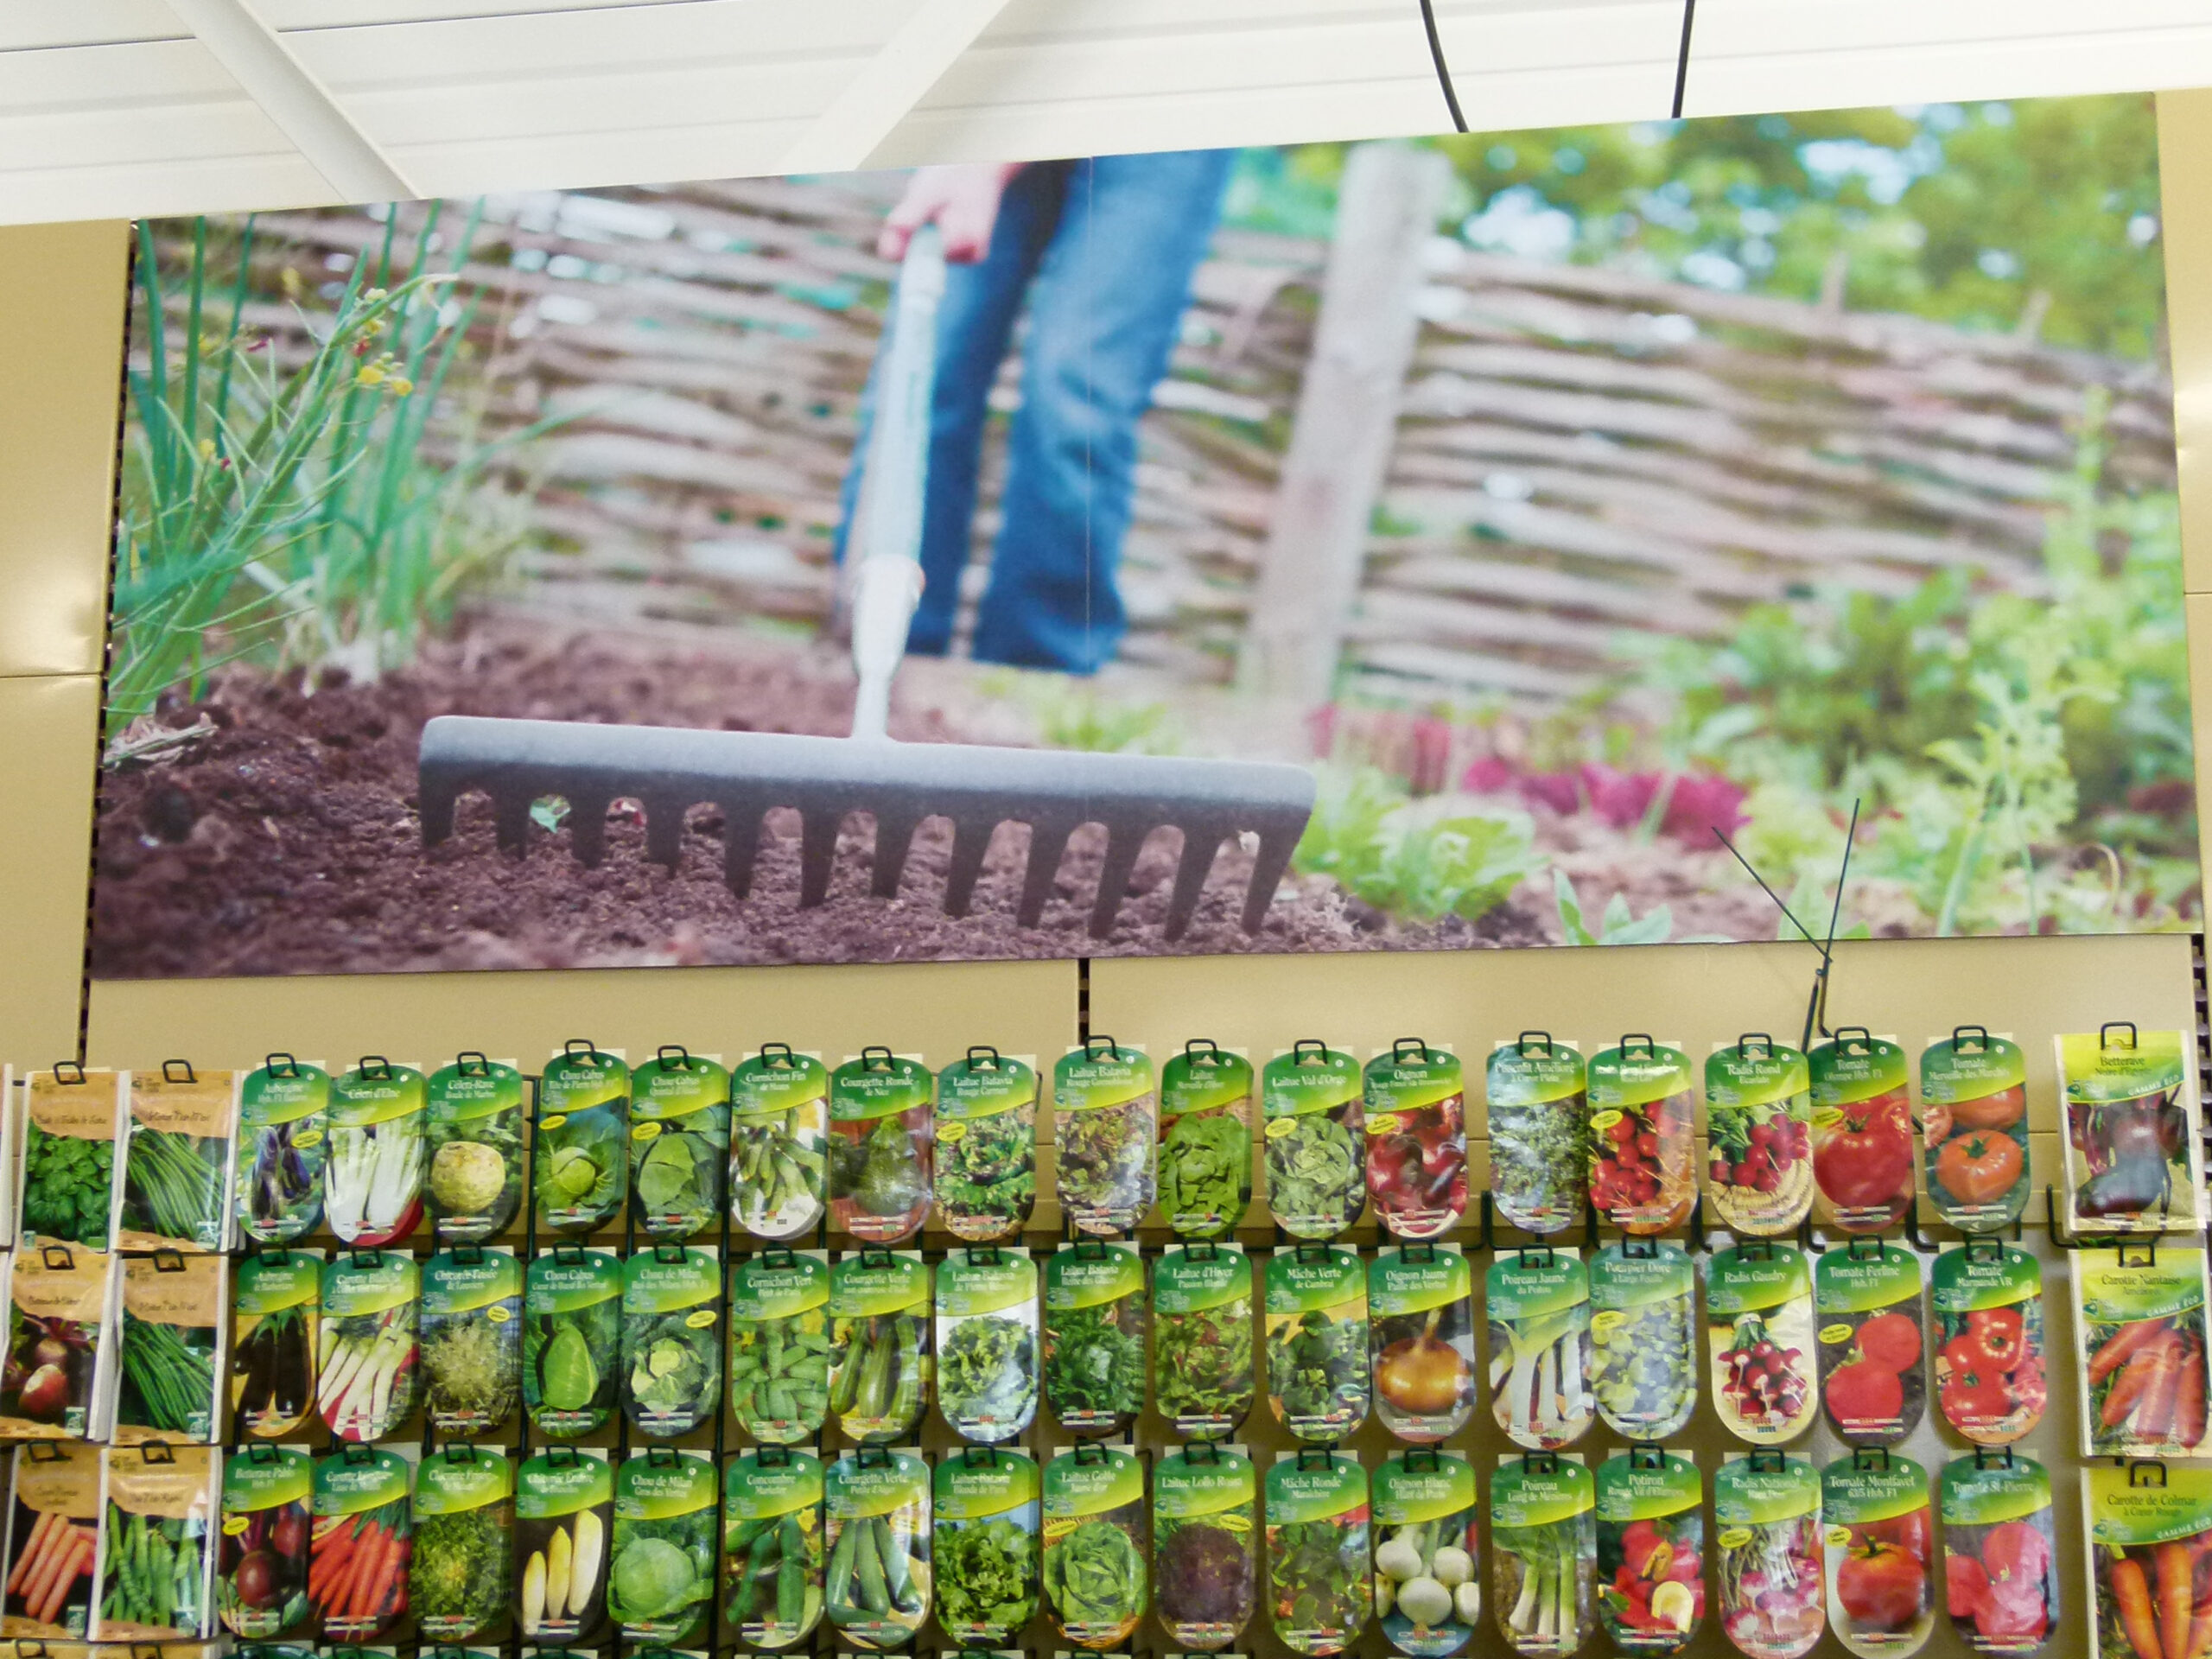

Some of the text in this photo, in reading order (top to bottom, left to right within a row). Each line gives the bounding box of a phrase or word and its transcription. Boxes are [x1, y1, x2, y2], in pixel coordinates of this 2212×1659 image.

[1835, 1058, 1870, 1071] Tomate
[1951, 1057, 1986, 1070] Tomate
[2101, 1057, 2145, 1066] Betterave
[560, 1070, 581, 1080] Chou
[1069, 1065, 1131, 1077] Laitue Batavia
[1190, 1070, 1214, 1079] Laitue
[1394, 1069, 1427, 1080] Oignon
[1728, 1063, 1780, 1076] Radis Rond
[652, 1076, 673, 1086] Chou
[746, 1072, 805, 1083] Cornichon Fin
[841, 1077, 913, 1089] Courgette Ronde
[954, 1075, 1013, 1086] Laitue Batavia
[1272, 1077, 1300, 1087] Laitue
[2128, 1081, 2161, 1096] GAMME
[545, 1269, 594, 1280] Chou Cabus
[640, 1269, 664, 1279] Chou
[665, 1268, 676, 1279] de
[1061, 1264, 1119, 1275] Laitue Batavia
[1173, 1268, 1200, 1278] Laitue
[1287, 1268, 1342, 1279] Mâche Verte
[1829, 1266, 1899, 1277] Tomate Ferline
[1966, 1265, 2001, 1276] Tomate
[747, 1275, 812, 1287] Cornichon Vert
[844, 1274, 886, 1286] Courgette
[952, 1272, 980, 1281] Laitue
[1386, 1269, 1447, 1282] Oignon Jaune
[1502, 1273, 1566, 1285] Poireau Jaune
[1725, 1270, 1786, 1283] Radis Gaudry
[2101, 1274, 2181, 1285] Carotte Nantaise
[2146, 1304, 2180, 1318] GAMME
[632, 1475, 692, 1487] Chou de Milan
[747, 1474, 796, 1484] Concombre
[839, 1472, 907, 1485] Courgette Verte
[1062, 1471, 1089, 1482] Laitue
[1162, 1477, 1190, 1487] Laitue
[1192, 1476, 1215, 1487] Lollo
[1281, 1477, 1342, 1487] Mâche Ronde
[1630, 1474, 1664, 1485] Potiron
[1829, 1474, 1915, 1487] Tomate Montfavet
[1389, 1478, 1451, 1491] Oignon Blanc
[1522, 1479, 1558, 1491] Poireau
[1732, 1478, 1799, 1488] Radis National
[1950, 1482, 1987, 1492] Tomate
[2107, 1494, 2196, 1505] Carotte de Colmar
[2156, 1524, 2192, 1540] GAMME
